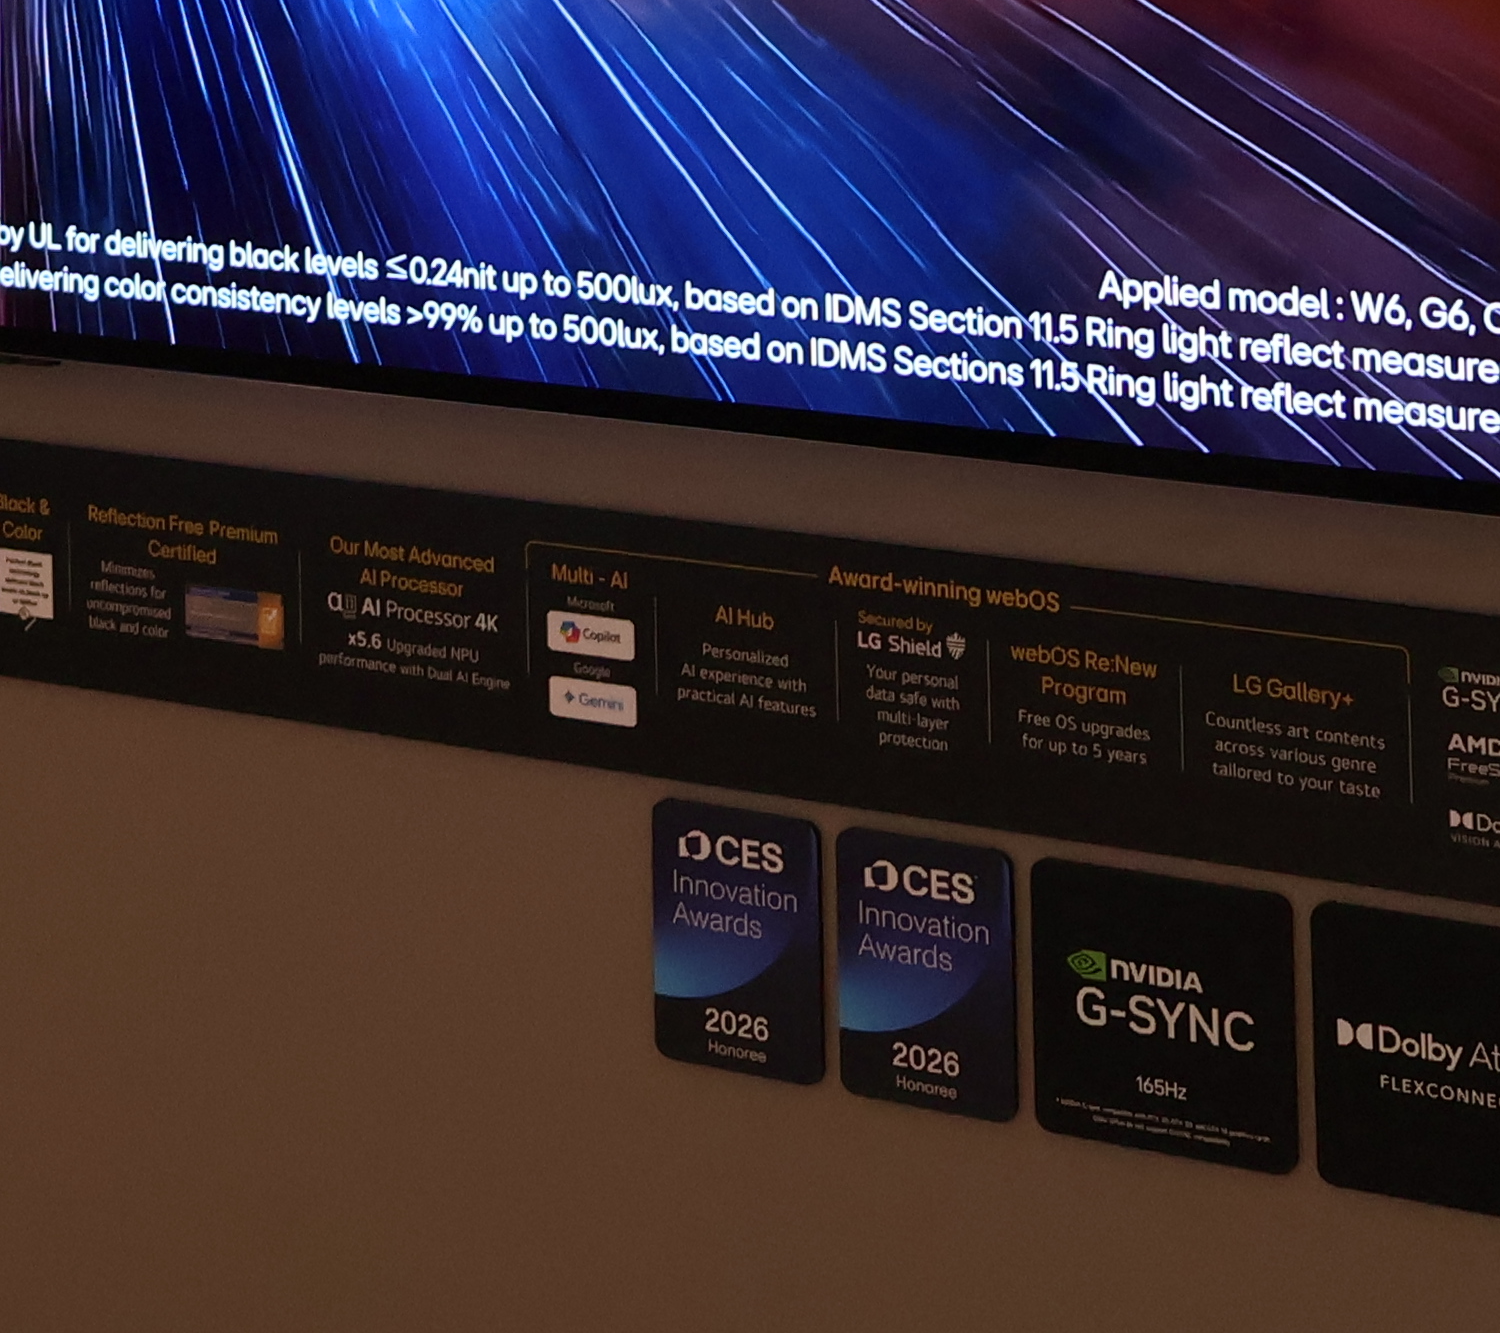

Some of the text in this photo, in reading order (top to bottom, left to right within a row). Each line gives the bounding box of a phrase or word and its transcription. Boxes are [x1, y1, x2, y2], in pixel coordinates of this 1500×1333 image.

[29, 222, 61, 251] UL
[66, 225, 99, 254] for
[104, 229, 224, 271] delivering
[229, 240, 298, 273] black
[305, 247, 379, 279] levels
[502, 270, 537, 300] up
[543, 270, 571, 297] to
[577, 271, 678, 311] 500lux,
[685, 281, 775, 316] based
[781, 294, 818, 321] on
[824, 293, 901, 329] IDMS
[908, 301, 1022, 340] Section
[1029, 312, 1079, 345] 11.5
[1086, 316, 1154, 359] Ring
[1162, 324, 1232, 363] light
[1239, 333, 1345, 369] reflect
[1099, 271, 1220, 311] Applied
[1228, 286, 1330, 320] model
[1351, 290, 1413, 331] W6,
[1420, 297, 1476, 336] G6,
[88, 505, 278, 544] Reflection Free Premium
[148, 540, 216, 565] Certified
[330, 536, 494, 573] Our Most Advanced
[360, 568, 463, 597] AI Processor
[829, 566, 1059, 612] Award-winning webOS
[362, 598, 497, 632] AI Processor 4K
[715, 605, 774, 630] AI Hub
[858, 631, 941, 657] LG Shield
[1011, 645, 1156, 678] webOS Re:New
[1042, 676, 1126, 704] Program
[1234, 674, 1353, 709] LG Gallery+
[716, 836, 783, 873] CES
[674, 869, 797, 912] Innovation
[903, 866, 974, 904] CES
[673, 902, 762, 939] Awards
[860, 900, 989, 944] Innovation
[859, 934, 952, 971] Awards
[706, 1008, 768, 1041] 2026
[1077, 987, 1254, 1051] G-SYNC
[893, 1042, 959, 1076] 2026
[1379, 1025, 1463, 1071] Dolby
[1137, 1076, 1186, 1100] 165Hz
